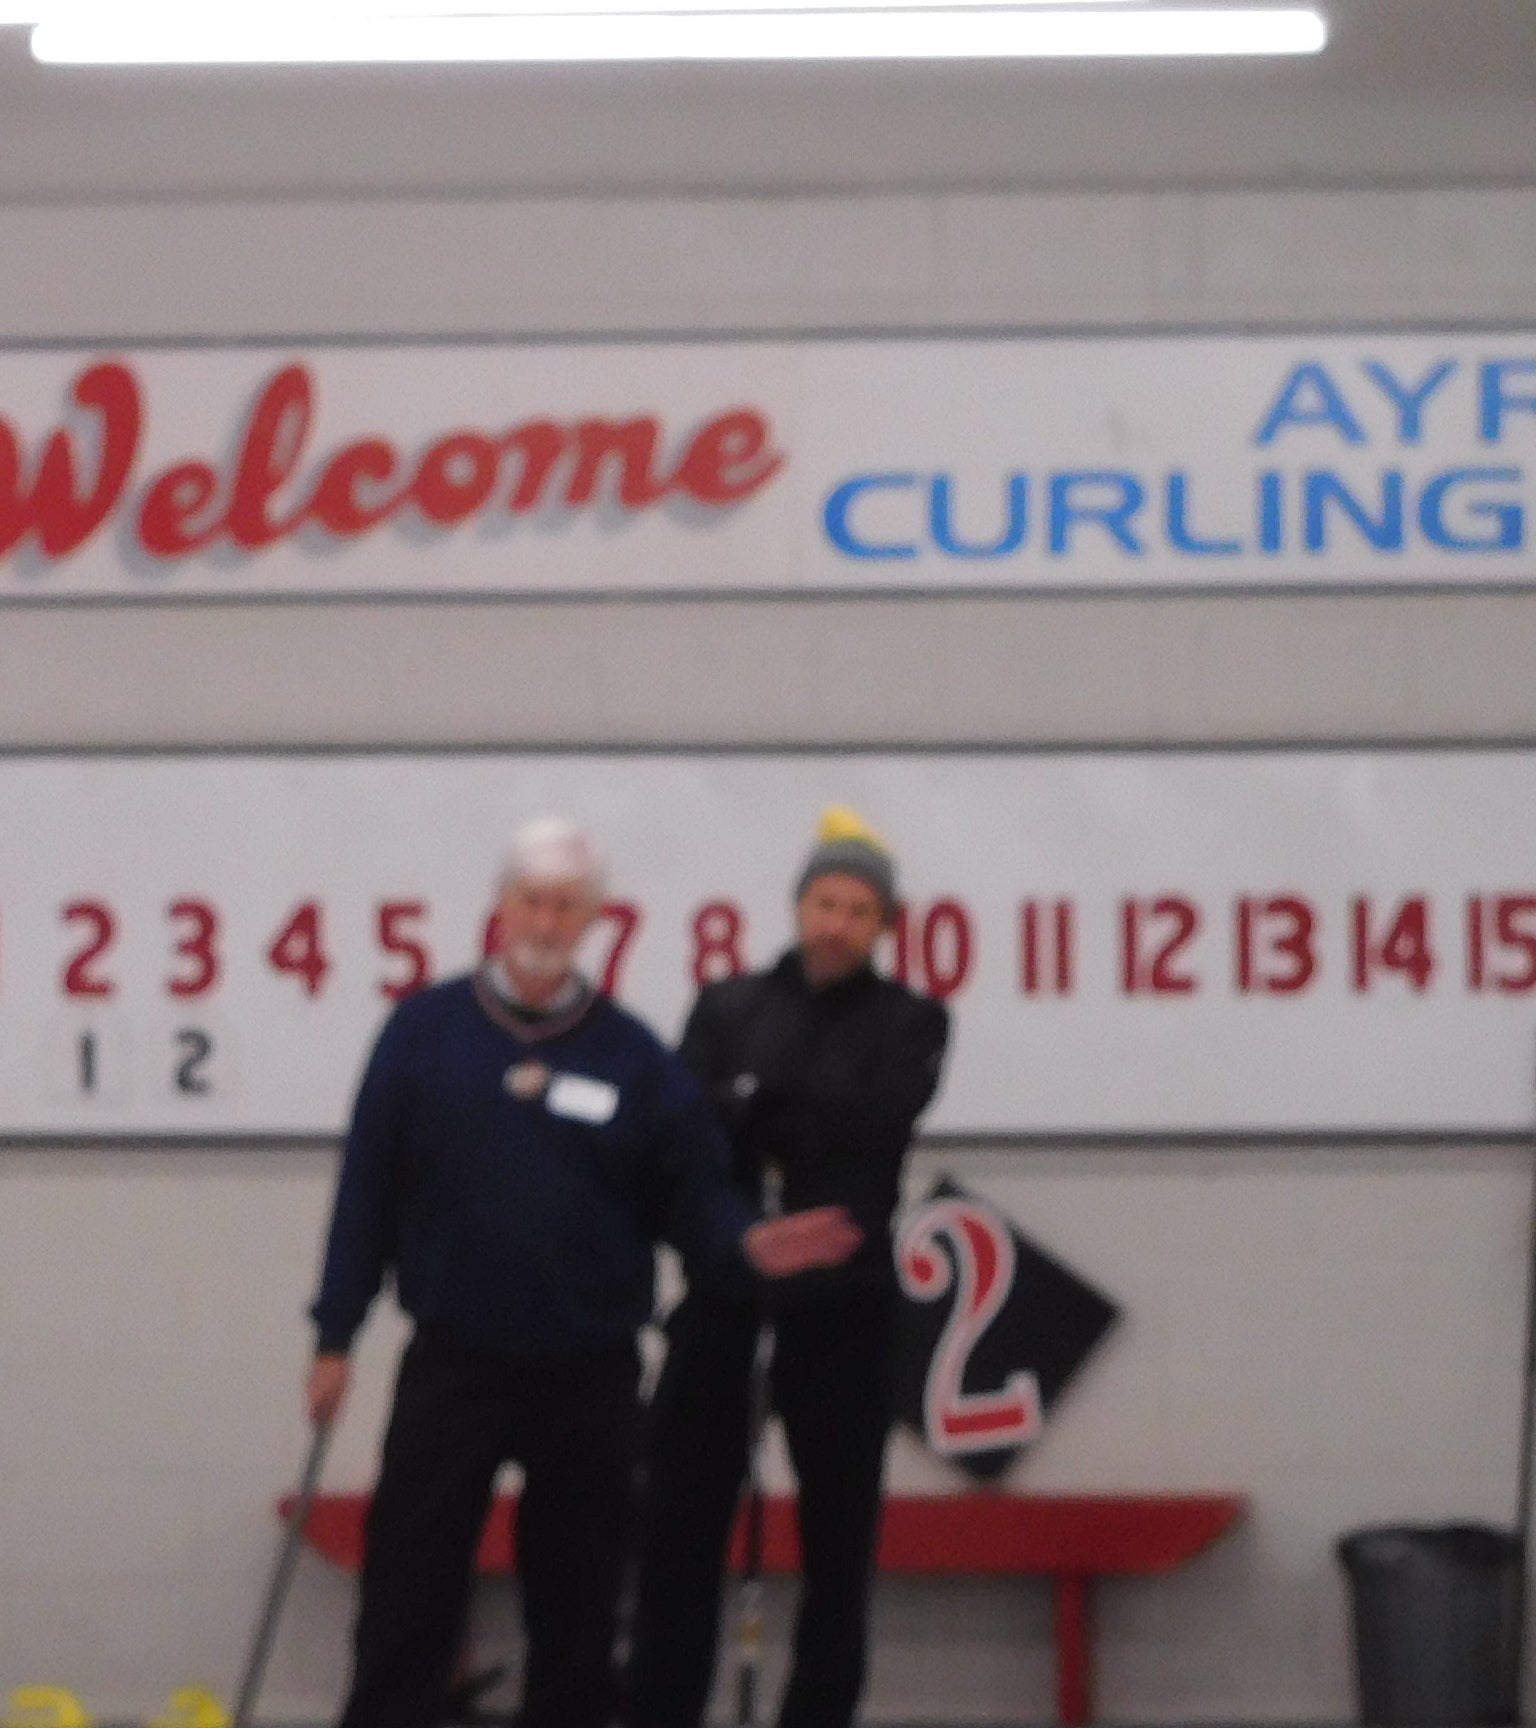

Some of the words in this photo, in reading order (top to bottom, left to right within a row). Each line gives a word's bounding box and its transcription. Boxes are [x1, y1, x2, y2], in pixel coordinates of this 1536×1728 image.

[820, 468, 1527, 560] CURLING
[61, 899, 118, 1000] 2
[168, 898, 222, 1000] 3
[266, 900, 332, 998] 4
[375, 900, 432, 1002] 5
[592, 899, 641, 998] 7
[690, 900, 750, 986] 8
[893, 900, 973, 998] 10
[1020, 900, 1073, 994] 11
[1122, 897, 1200, 995] 12
[1236, 896, 1318, 995] 13
[1352, 896, 1436, 993] 14
[1468, 896, 1536, 993] 15
[75, 1027, 100, 1097] 1
[171, 1026, 216, 1098] 2
[894, 1200, 1042, 1456] 2
